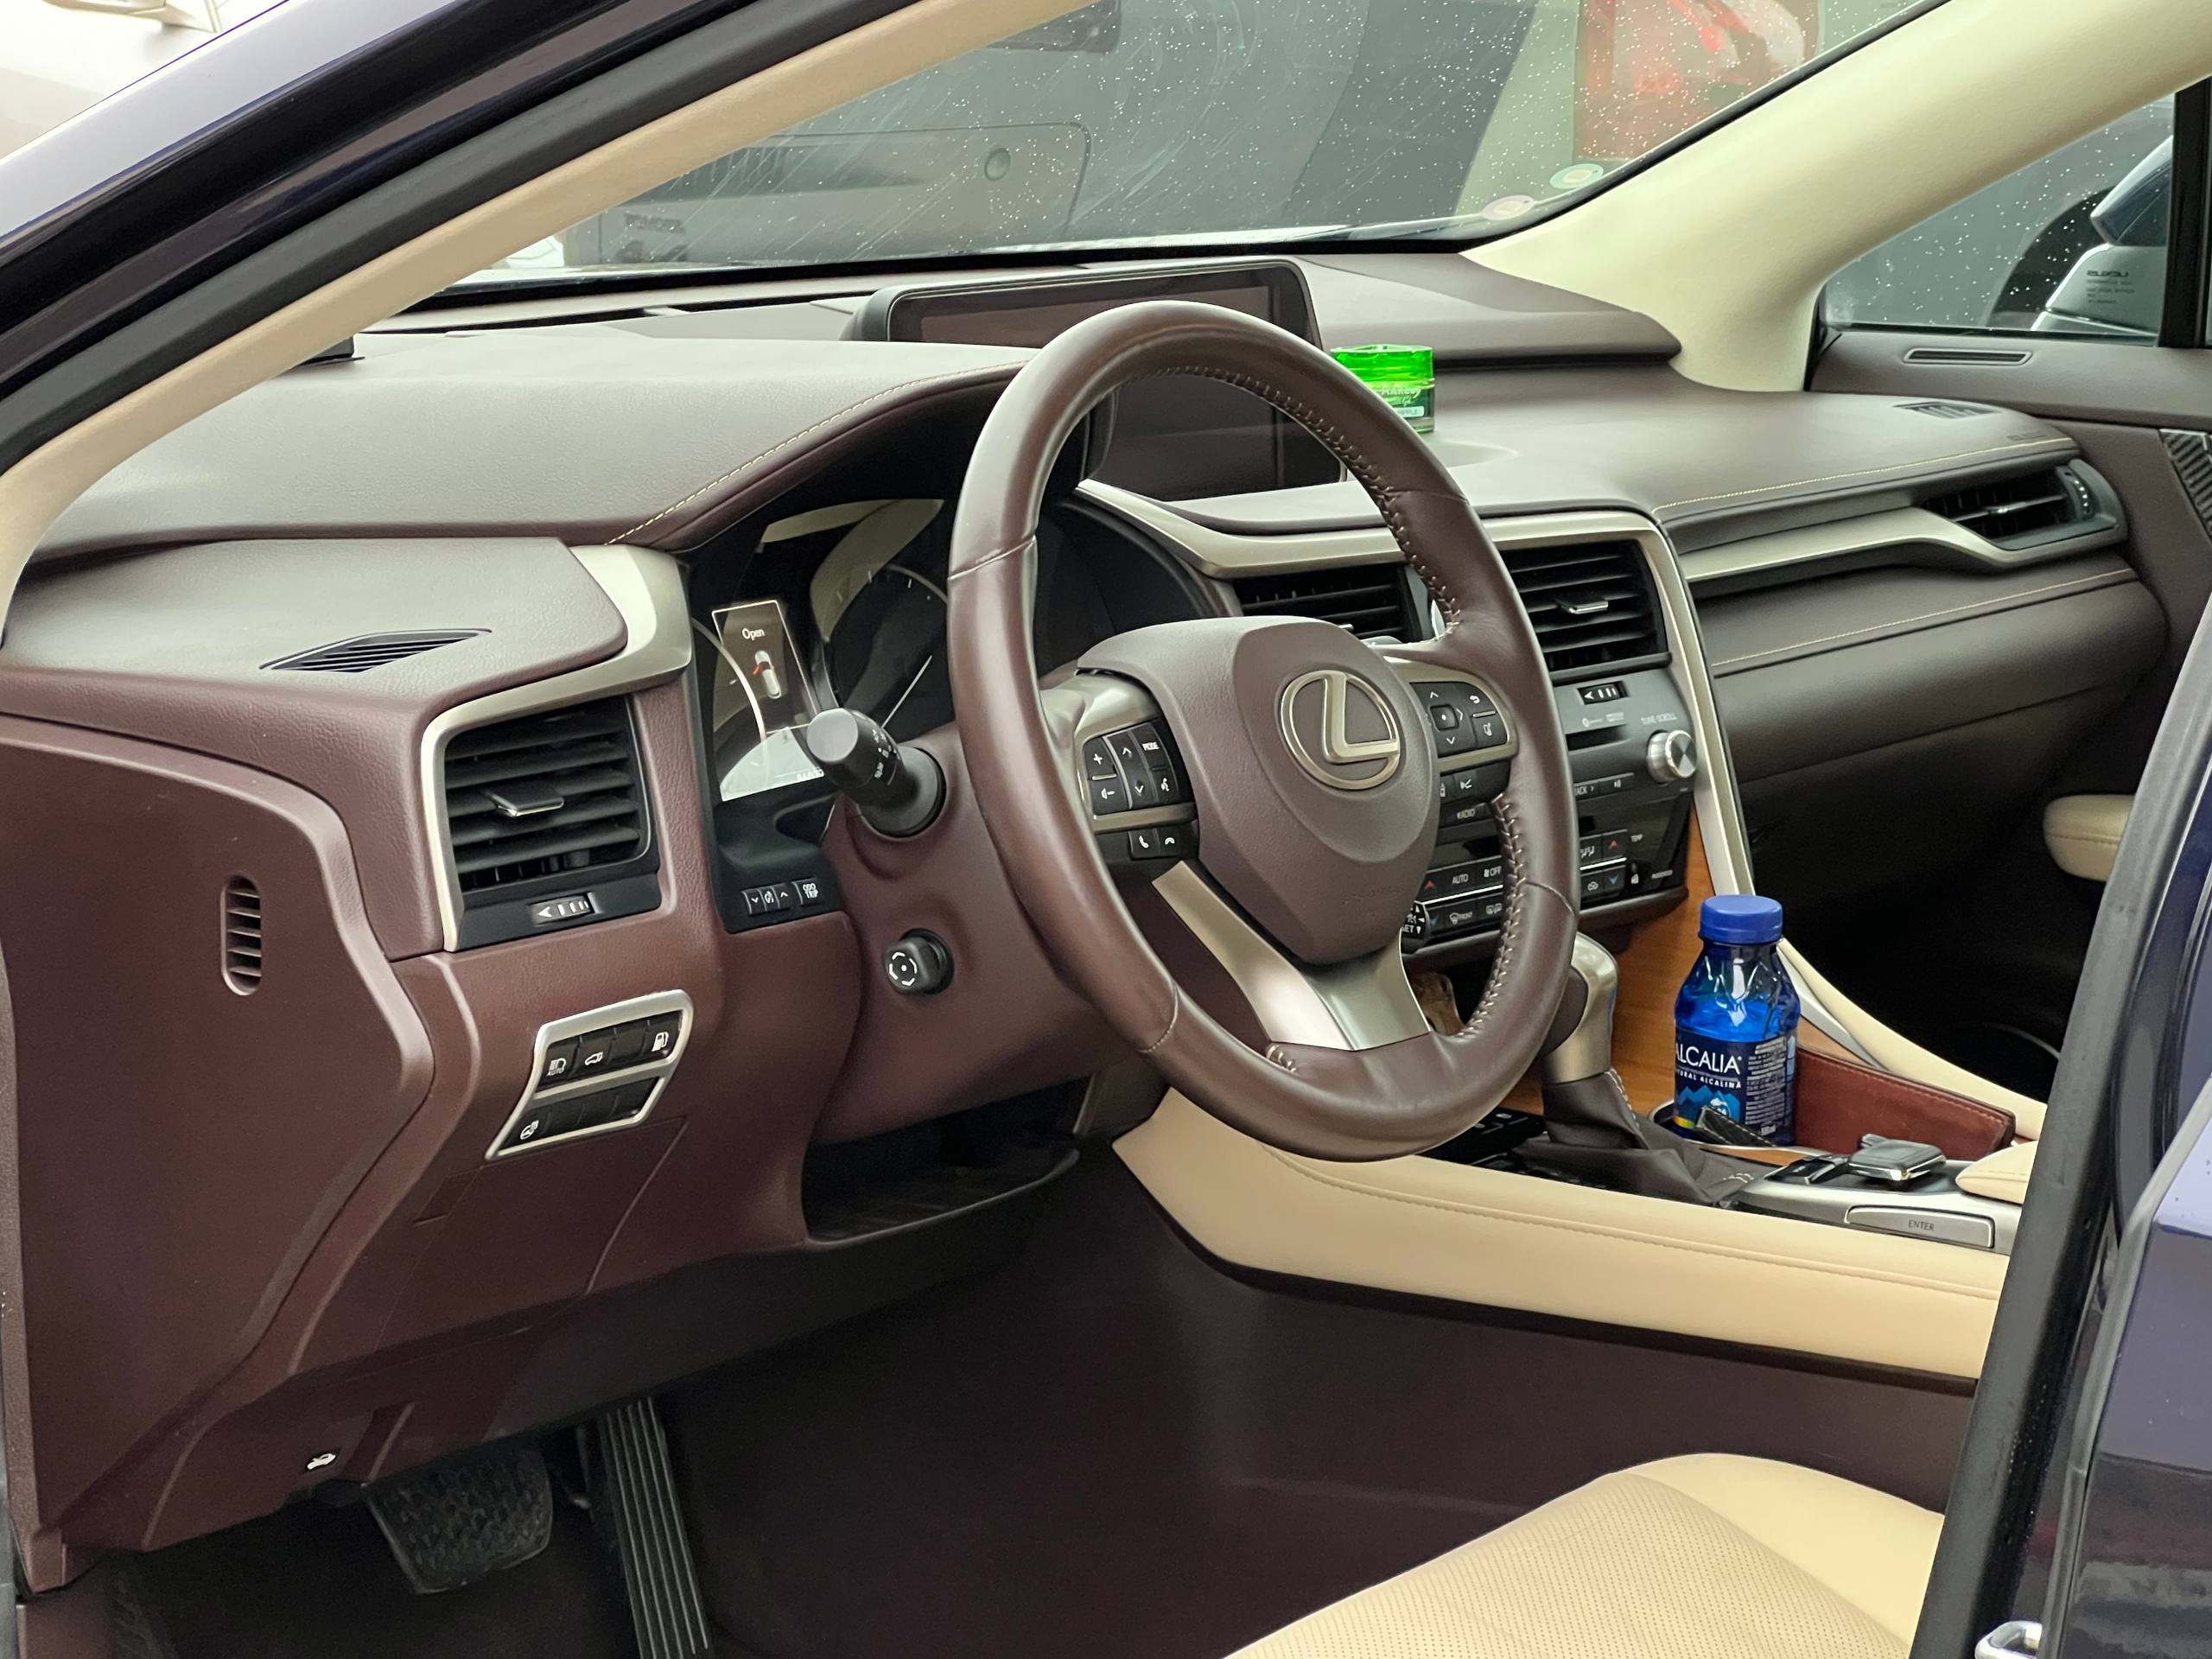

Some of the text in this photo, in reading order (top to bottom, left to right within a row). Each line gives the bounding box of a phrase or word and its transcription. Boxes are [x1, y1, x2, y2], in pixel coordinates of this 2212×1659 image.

[741, 627, 766, 641] Open
[1490, 866, 1503, 876] OFF
[1452, 874, 1469, 886] AUTO
[1908, 1219, 1935, 1231] ENTER
